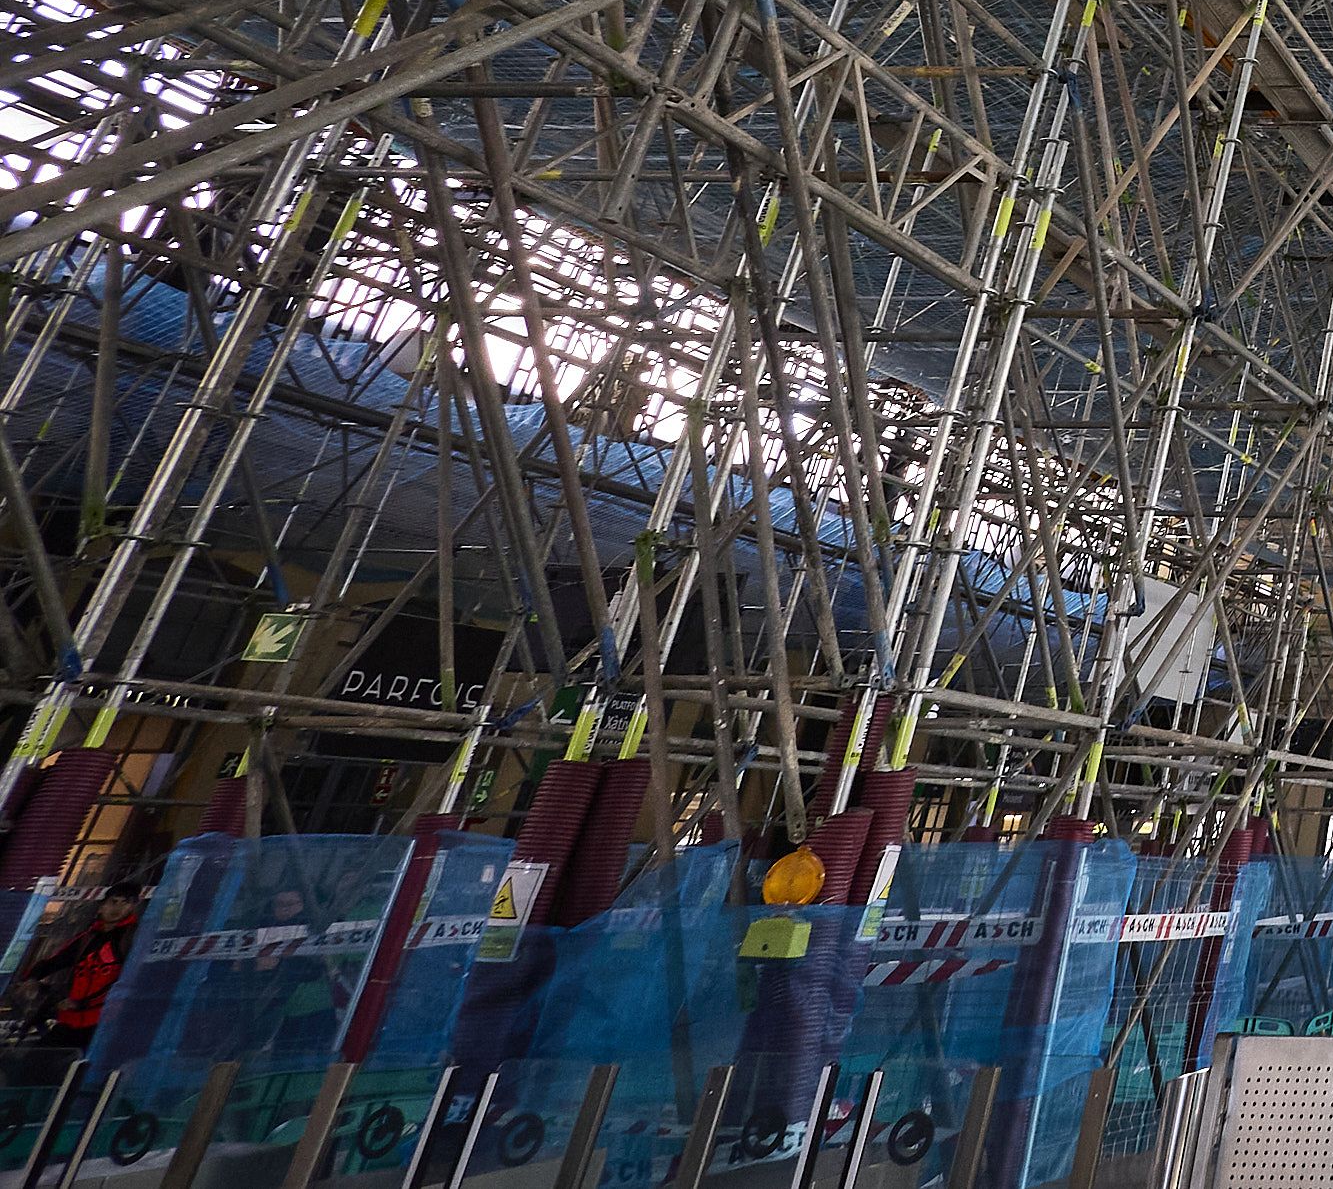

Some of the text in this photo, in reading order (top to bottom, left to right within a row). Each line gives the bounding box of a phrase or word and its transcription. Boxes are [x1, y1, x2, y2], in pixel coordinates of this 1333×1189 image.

[879, 924, 919, 942] SCH
[974, 920, 1034, 939] ASCH
[1128, 917, 1155, 933] ASCH
